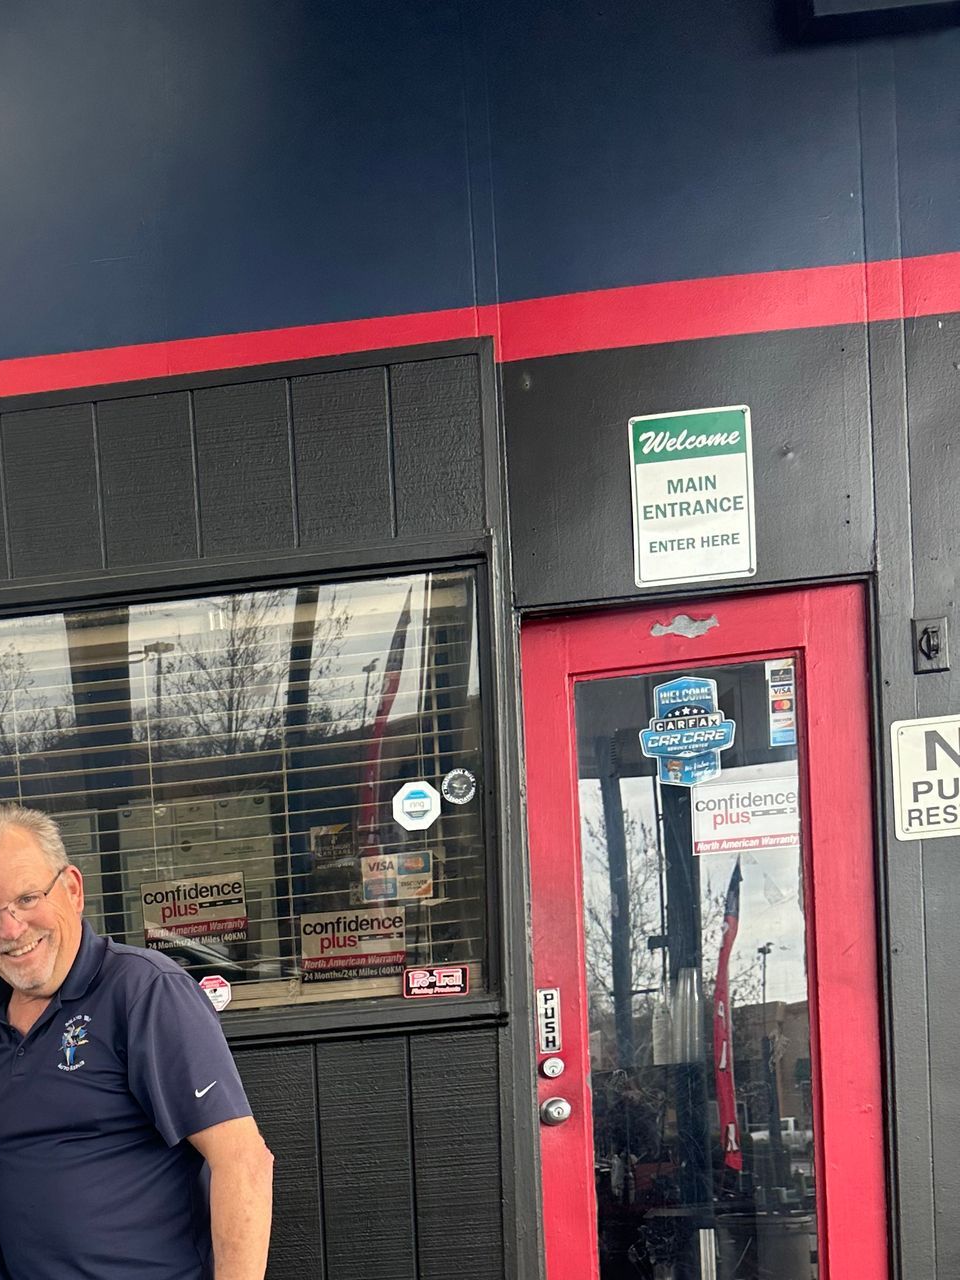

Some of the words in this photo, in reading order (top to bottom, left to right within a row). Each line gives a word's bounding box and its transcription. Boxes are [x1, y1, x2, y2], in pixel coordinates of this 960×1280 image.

[639, 429, 741, 455] Welcome
[667, 475, 717, 494] MAIN
[643, 495, 744, 520] ENTRANCE
[649, 537, 696, 553] ENTER
[700, 533, 740, 548] HERE
[660, 687, 712, 704] WELCOME
[655, 717, 720, 731] CARFAX
[648, 734, 681, 748] CAR
[682, 729, 726, 743] CARE
[695, 791, 797, 812] confidence
[713, 809, 751, 830] plus
[697, 838, 720, 851] North
[721, 836, 760, 849] American
[761, 833, 798, 846] Warranty
[368, 860, 395, 872] VISA
[143, 881, 242, 905] confidence
[161, 901, 198, 923] plus
[170, 924, 208, 935] American
[209, 919, 245, 931] Warranty
[302, 915, 403, 936] confidence
[201, 935, 221, 944] Miles
[221, 931, 247, 943] (40KM)
[320, 933, 357, 954] plus
[304, 959, 326, 969] North
[327, 957, 365, 967] American
[367, 953, 404, 965] Warranty
[358, 966, 378, 976] Miles
[408, 968, 463, 987] Pro-Troll
[543, 993, 556, 1048] PUSH
